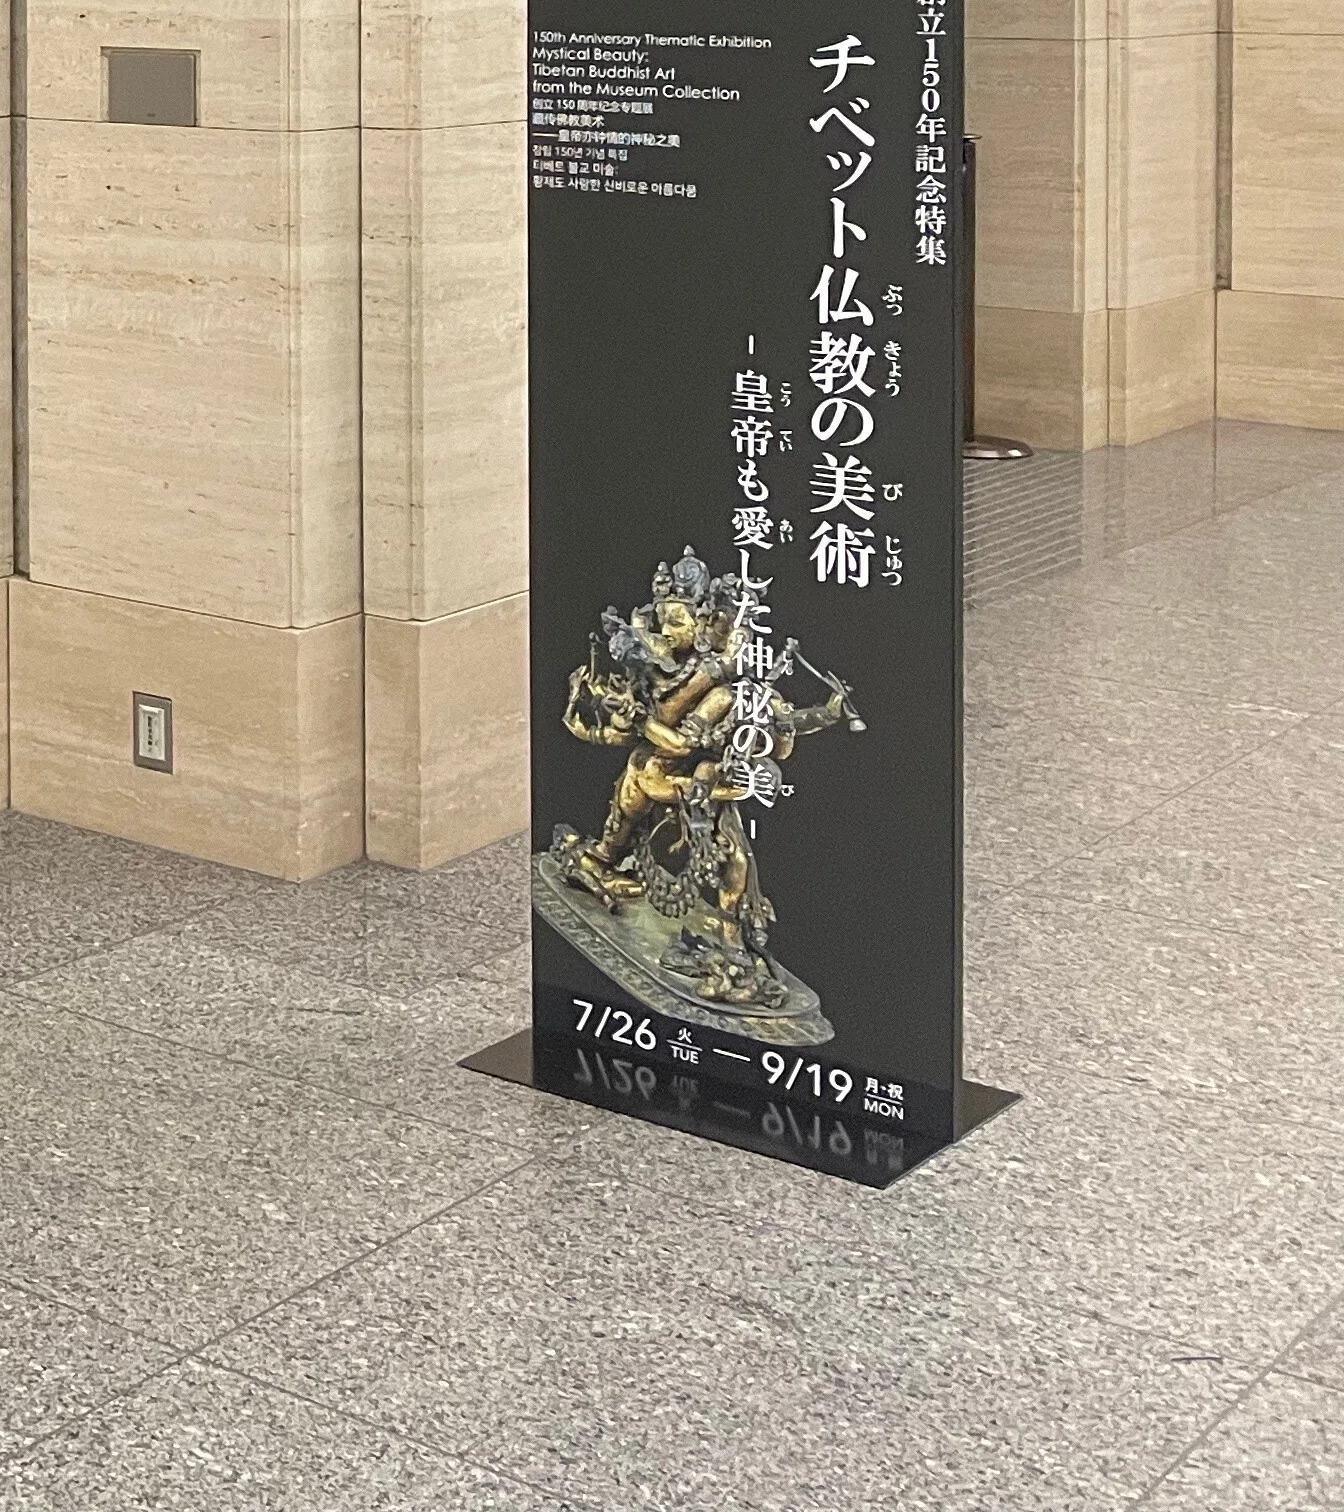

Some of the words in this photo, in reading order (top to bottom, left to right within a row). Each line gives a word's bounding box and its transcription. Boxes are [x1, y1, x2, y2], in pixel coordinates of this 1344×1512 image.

[534, 31, 567, 44] 150th
[569, 32, 642, 48] Anniversary
[645, 33, 706, 48] Thematic
[709, 35, 772, 49] Exhibition
[532, 47, 591, 63] Mystical
[593, 47, 650, 65] Beauty:
[532, 62, 585, 78] Tibetan
[588, 64, 651, 80] Buddhist
[654, 67, 676, 81] Art
[532, 79, 565, 94] from
[569, 81, 592, 95] the
[596, 82, 659, 97] Museum
[662, 85, 741, 101] Collection
[557, 99, 576, 111] 150
[808, 34, 877, 589] チベット仏教の美術
[882, 284, 904, 316] ぶつ
[883, 340, 903, 398] きょう
[780, 382, 792, 408] こう
[779, 429, 793, 453] てい
[882, 483, 904, 502] び
[881, 535, 904, 587] じゅつ
[572, 998, 657, 1051] 7/26
[676, 1026, 693, 1044] 火
[669, 1045, 700, 1065] TUE
[761, 1050, 853, 1103] 9/19
[863, 1098, 904, 1121] MON
